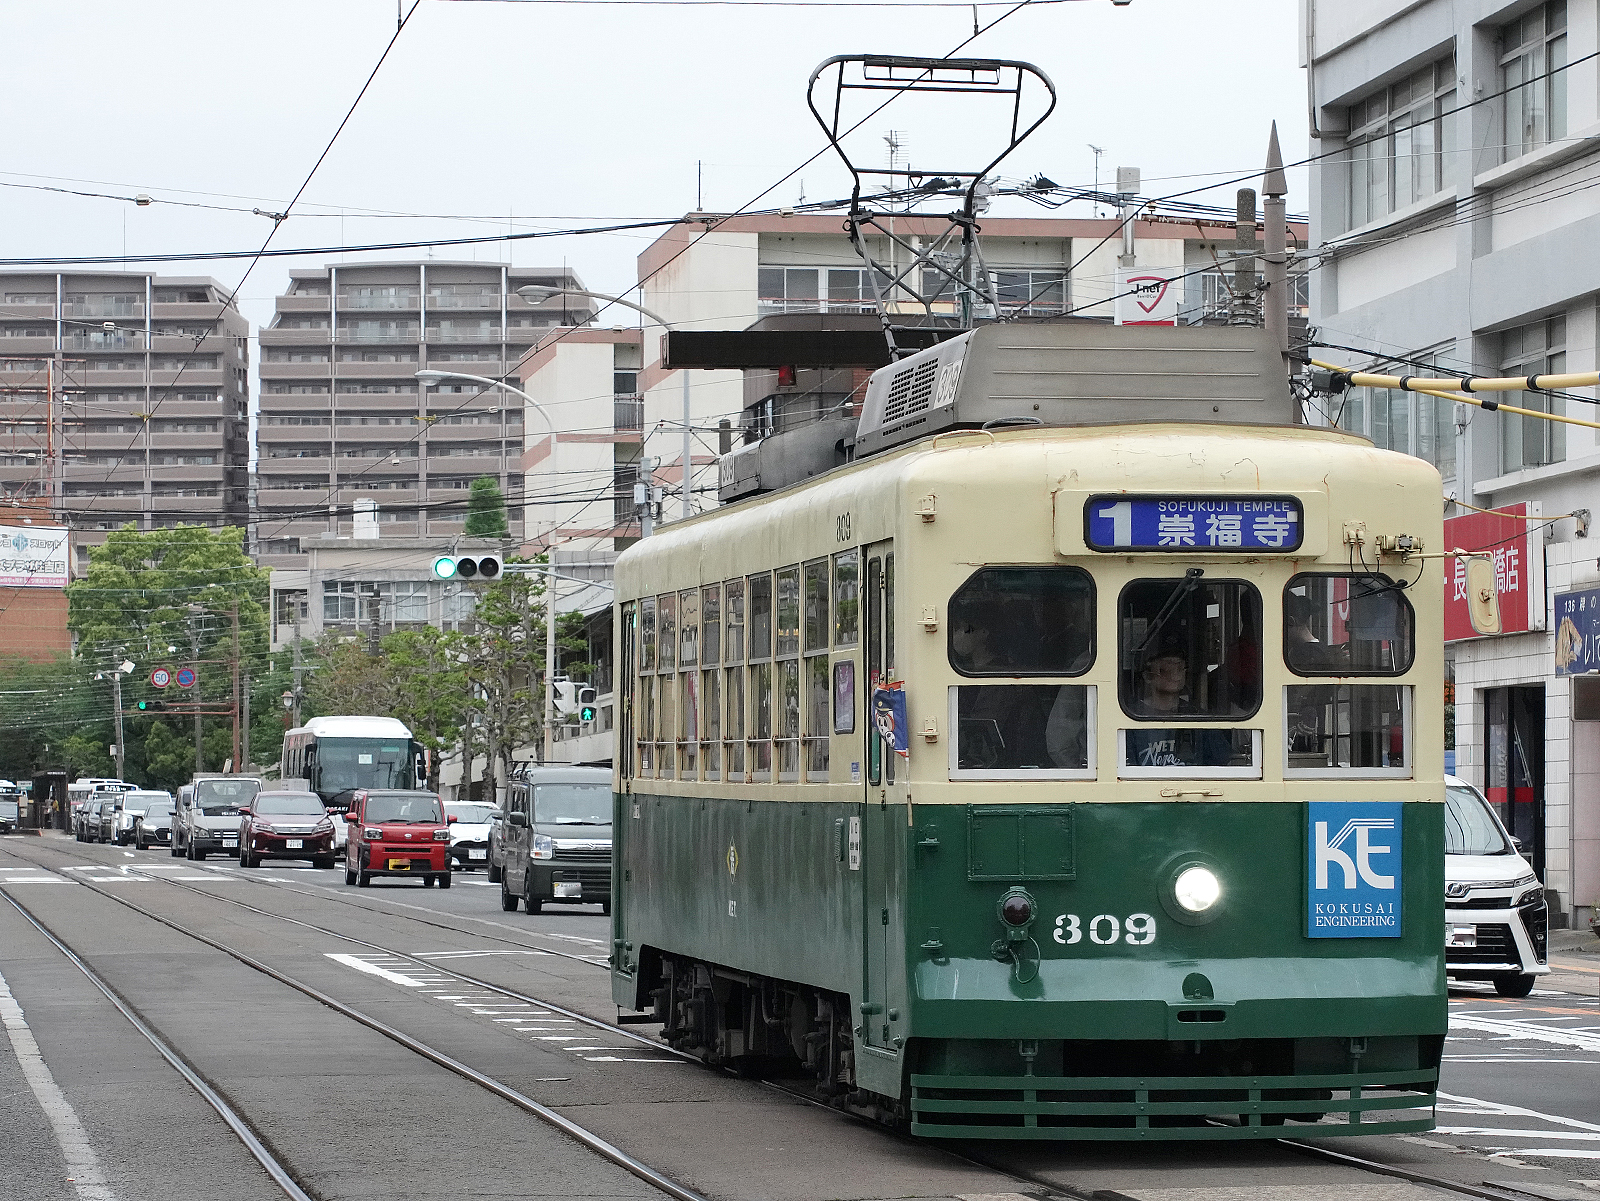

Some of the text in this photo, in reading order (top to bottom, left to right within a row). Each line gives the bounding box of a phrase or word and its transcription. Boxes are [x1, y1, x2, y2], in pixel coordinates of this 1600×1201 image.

[836, 511, 851, 543] 309
[1099, 501, 1290, 547] 1 SOFUKUJI TEMPLE
[1158, 514, 1290, 547] 崇福寺
[155, 673, 168, 683] 50
[1315, 818, 1395, 889] KE
[1315, 903, 1394, 914] KOKUSAI
[1315, 915, 1396, 928] ENGINEERING
[1053, 913, 1157, 945] 309
